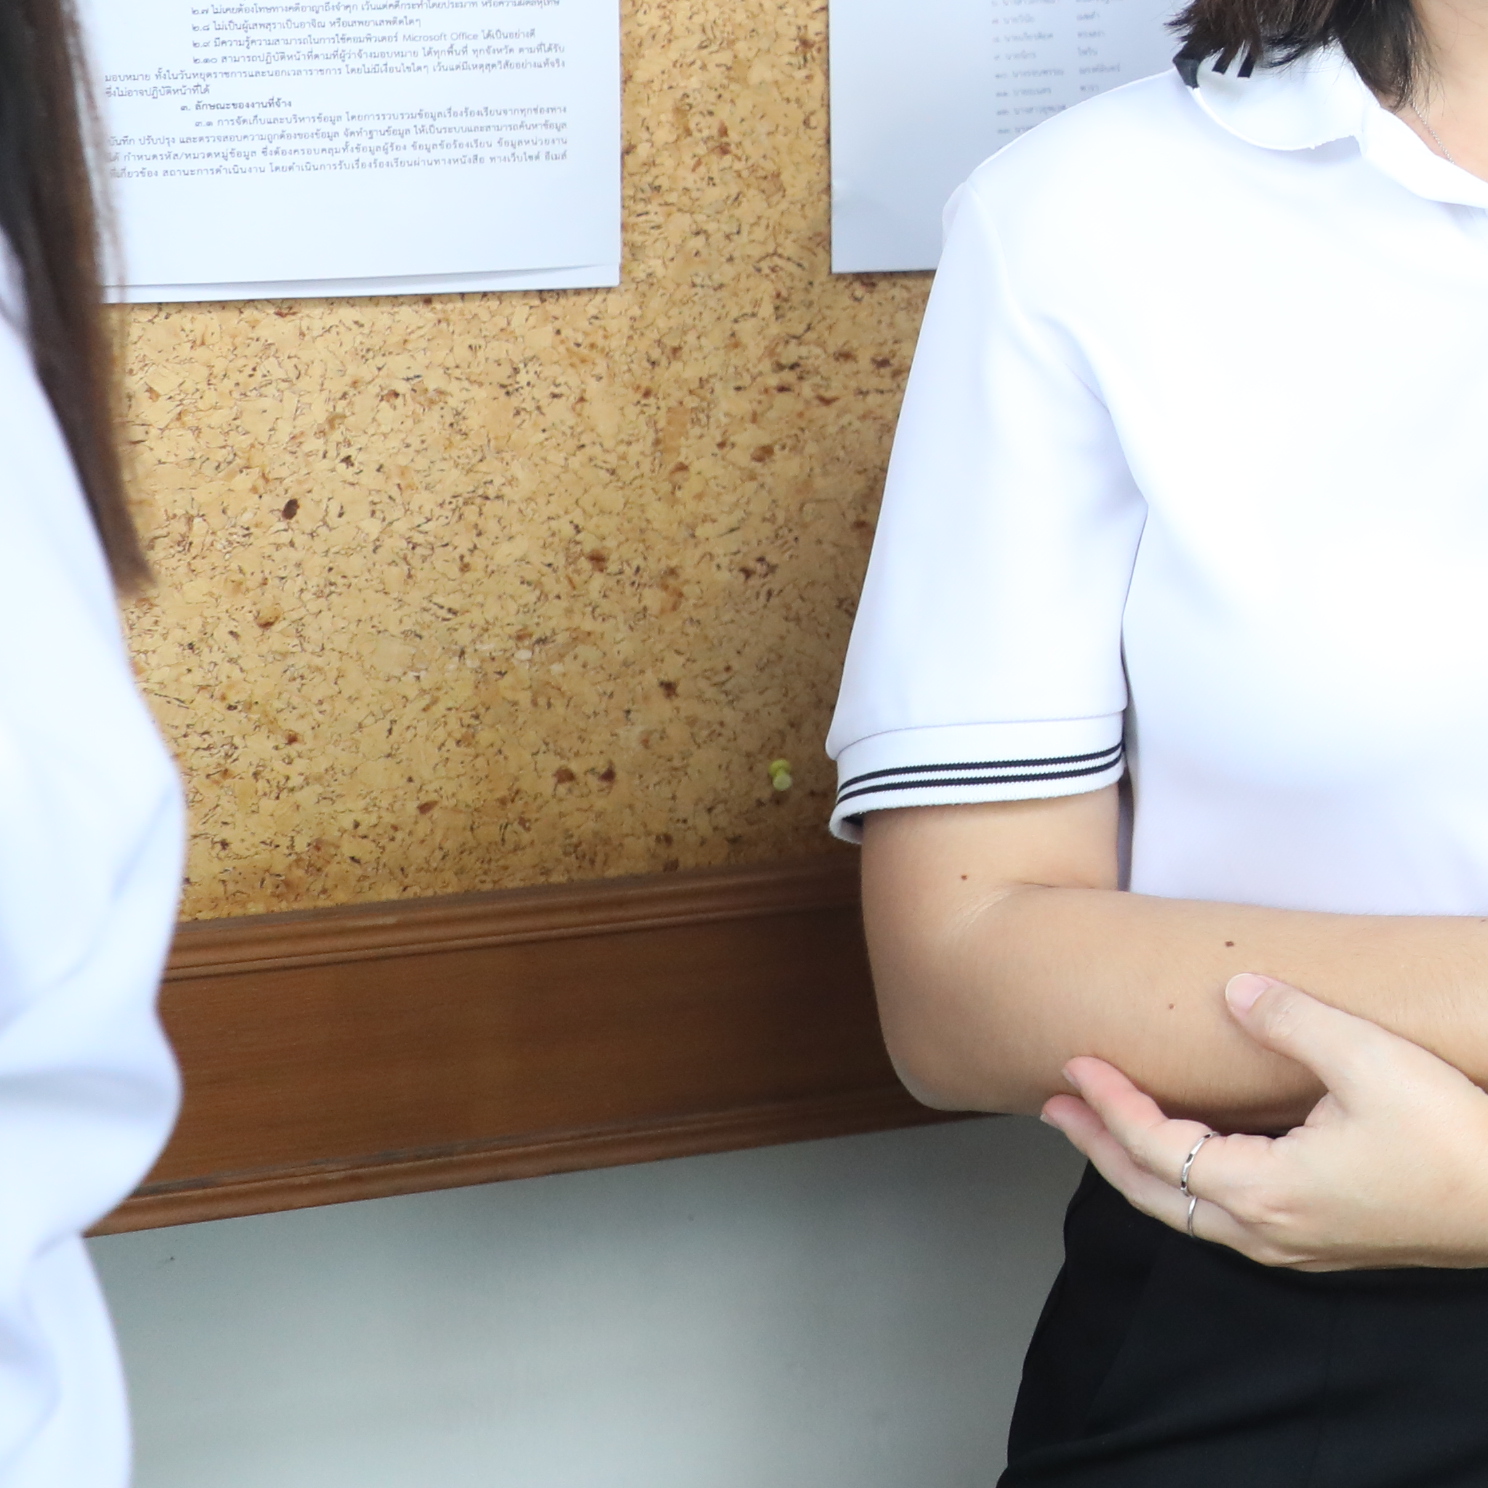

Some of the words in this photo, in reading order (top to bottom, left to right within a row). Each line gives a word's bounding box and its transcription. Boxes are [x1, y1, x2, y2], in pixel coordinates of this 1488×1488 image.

[191, 7, 209, 15] ๒.๗
[192, 24, 210, 32] ๒.๘
[192, 40, 211, 48] ๒.๙
